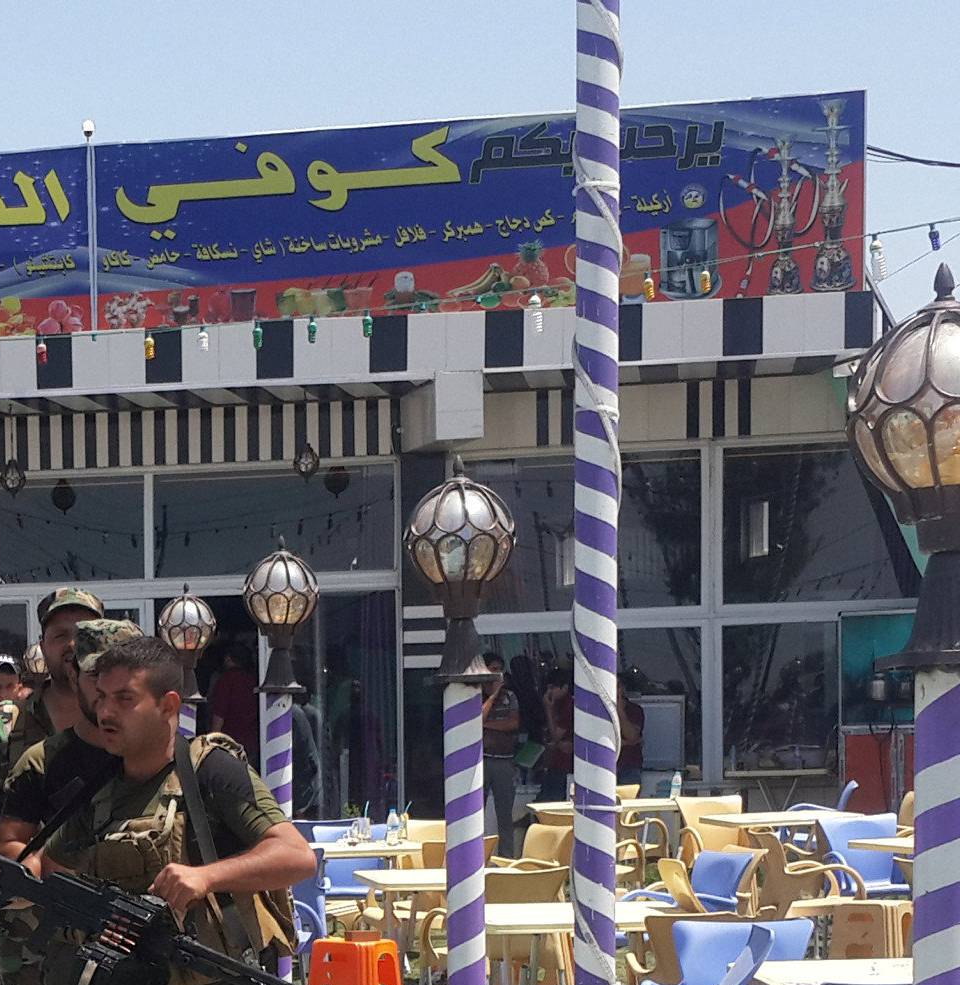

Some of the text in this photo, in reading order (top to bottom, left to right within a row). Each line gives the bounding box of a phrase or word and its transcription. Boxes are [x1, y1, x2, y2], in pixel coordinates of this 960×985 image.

[114, 126, 461, 241] كوفي
[394, 223, 427, 248] فلافل
[495, 214, 531, 237] دجاج
[328, 228, 384, 255] مشروبات
[102, 249, 132, 272] كاكاو
[146, 248, 180, 269] حامض
